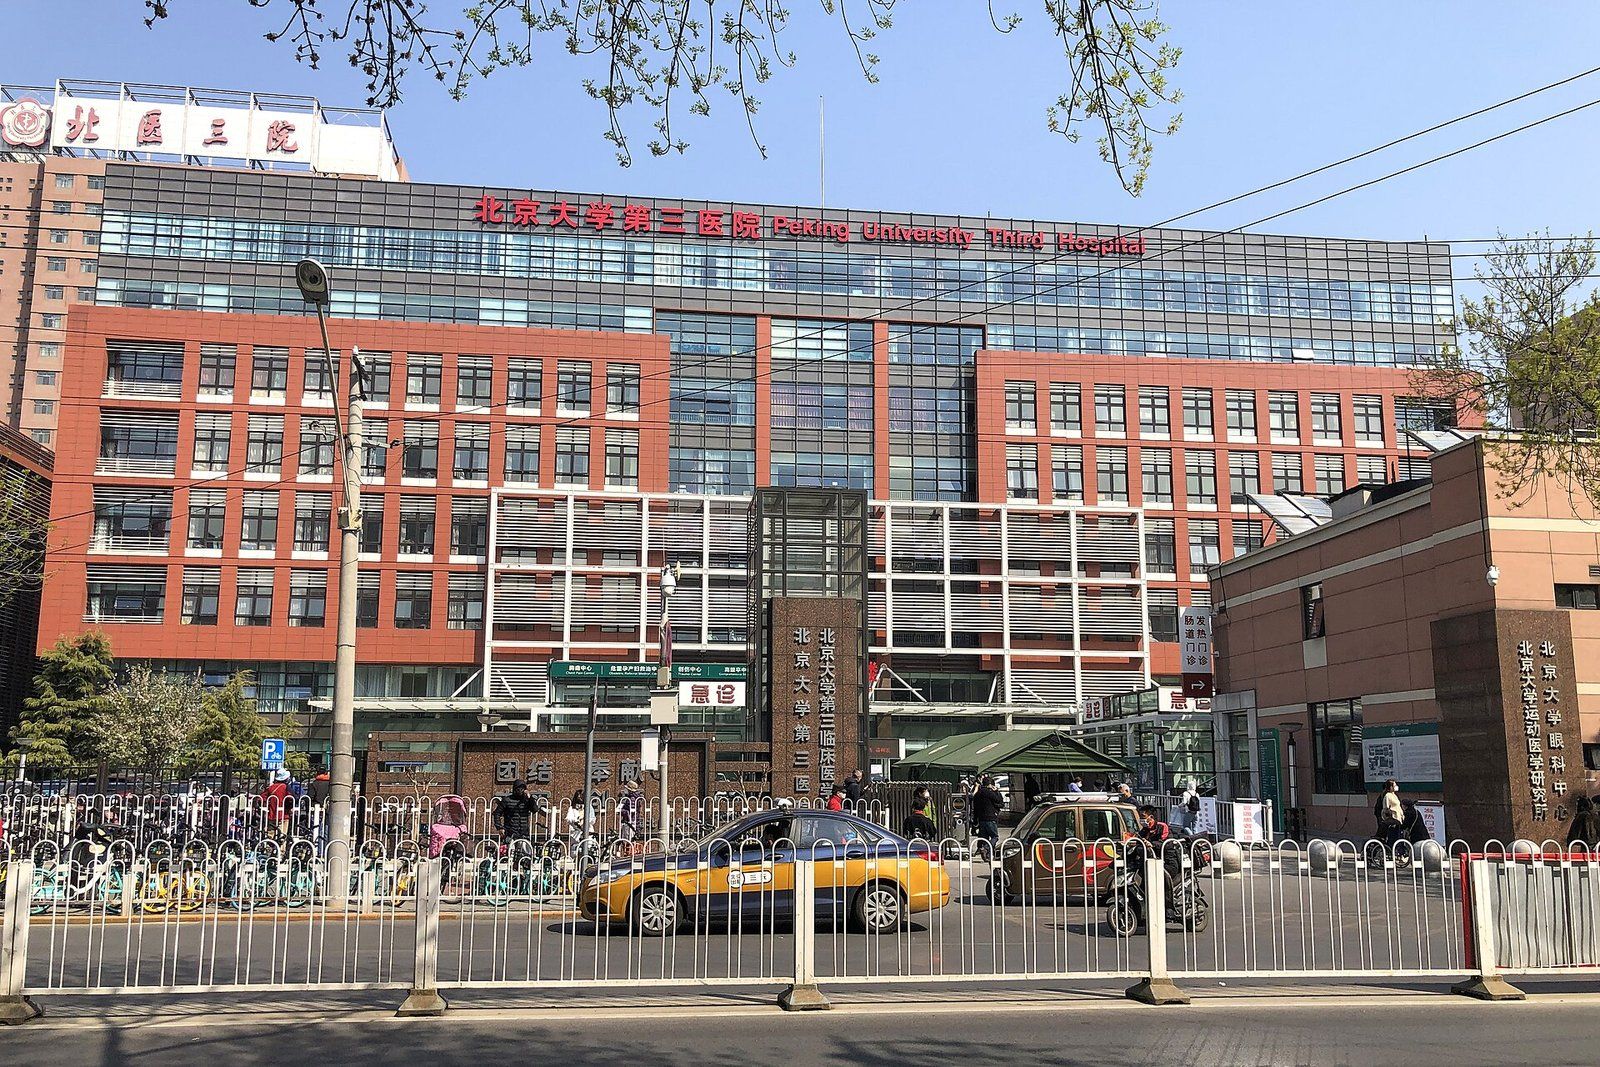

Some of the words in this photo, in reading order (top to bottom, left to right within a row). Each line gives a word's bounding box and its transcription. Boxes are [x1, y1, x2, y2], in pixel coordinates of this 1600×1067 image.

[65, 104, 299, 153] 北医三院
[475, 194, 761, 239] 北京大学第三医院
[773, 215, 849, 242] Peking
[862, 221, 974, 250] University
[988, 227, 1043, 250] Third
[1058, 231, 1146, 257] Hospital
[1184, 615, 1196, 666] 肠道门诊
[1196, 615, 1208, 666] 发热门诊
[691, 684, 735, 704] 急诊
[264, 742, 276, 760] P
[1518, 640, 1548, 820] 北京大学运动医学研究所
[1540, 640, 1568, 820] 北京大学眼科中心
[496, 759, 553, 782] 团结
